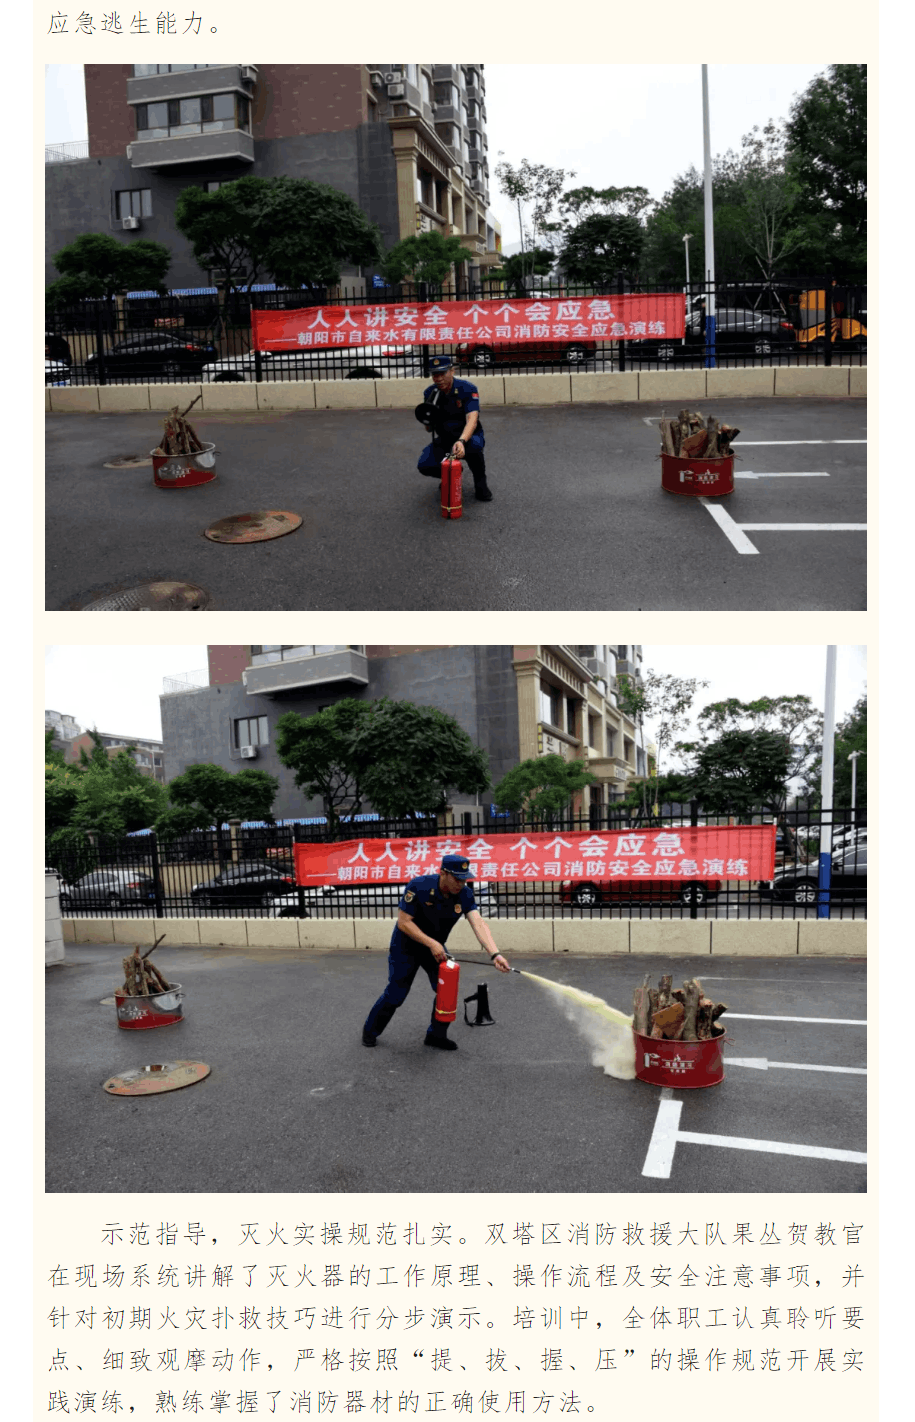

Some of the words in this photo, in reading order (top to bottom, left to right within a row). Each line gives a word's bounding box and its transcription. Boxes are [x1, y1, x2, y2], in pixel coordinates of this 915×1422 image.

[47, 10, 218, 35] 应急逃生能力。
[308, 305, 449, 329] 人人讲安全
[463, 299, 616, 324] 个个会应急
[348, 838, 494, 864] 人人讲安全
[510, 832, 686, 860] 个个会应急
[306, 858, 749, 881] ——朝阳市自来水限责任公司消防安全应急演练
[101, 1221, 864, 1247] 示范指导，灭火实操规范扎实。双塔区消防救援大队果丛贺教官
[47, 1263, 865, 1289] 在现场系统讲解了灭火器的工作原理、操作流程及安全注意事项，并
[47, 1305, 865, 1331] 针对初期火灾扑救技巧进行分步演示。培训中，全体职工认真聆听要
[47, 1389, 595, 1414] 践演练，熟练掌握了消防器材的正确使用方法。
